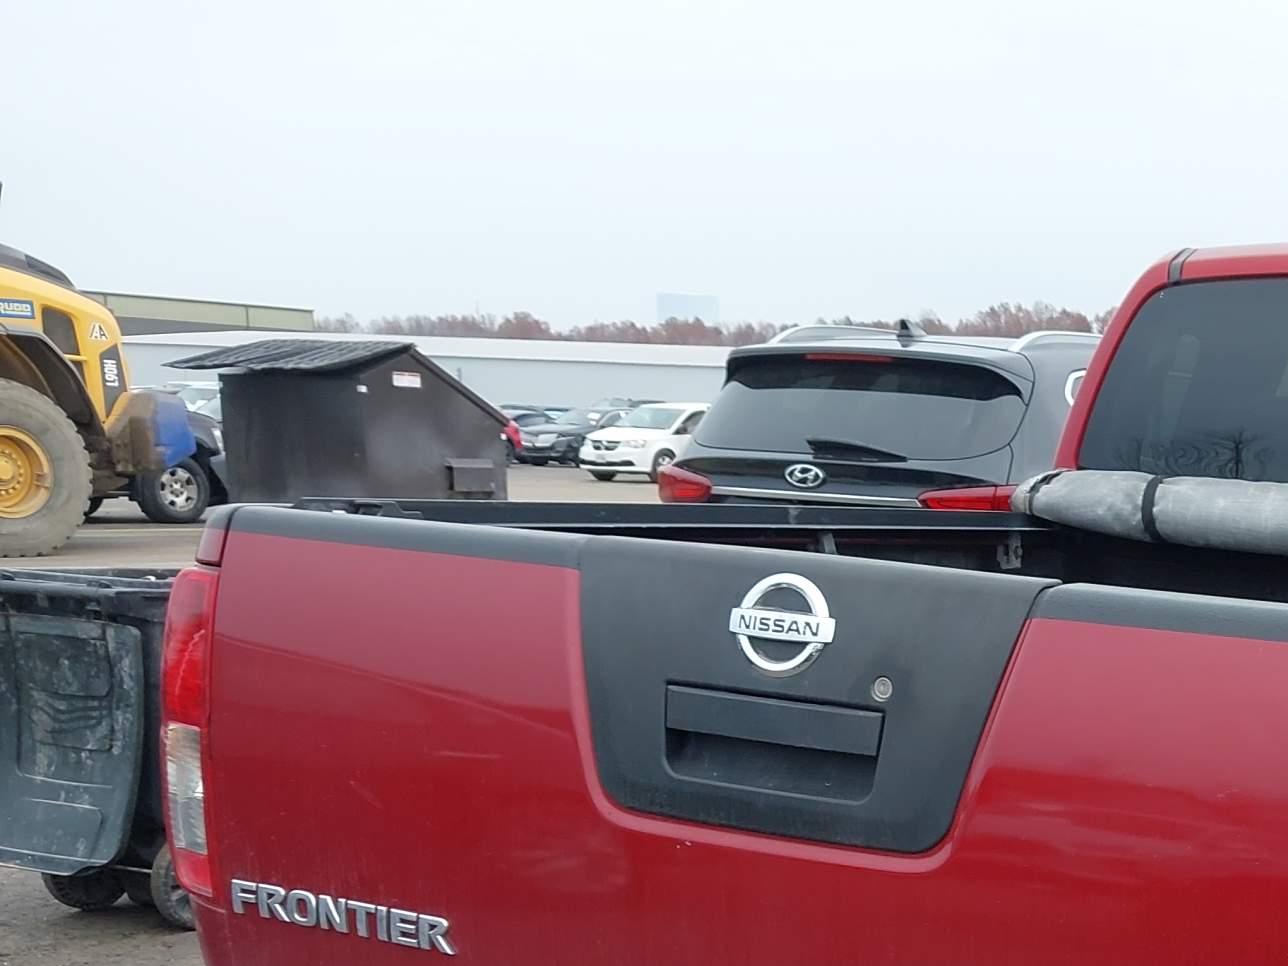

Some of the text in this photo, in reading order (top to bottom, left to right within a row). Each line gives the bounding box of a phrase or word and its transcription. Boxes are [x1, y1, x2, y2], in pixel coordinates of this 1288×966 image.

[103, 359, 119, 387] L90H
[738, 614, 820, 637] NISSAN
[231, 879, 457, 955] FRONTIER
